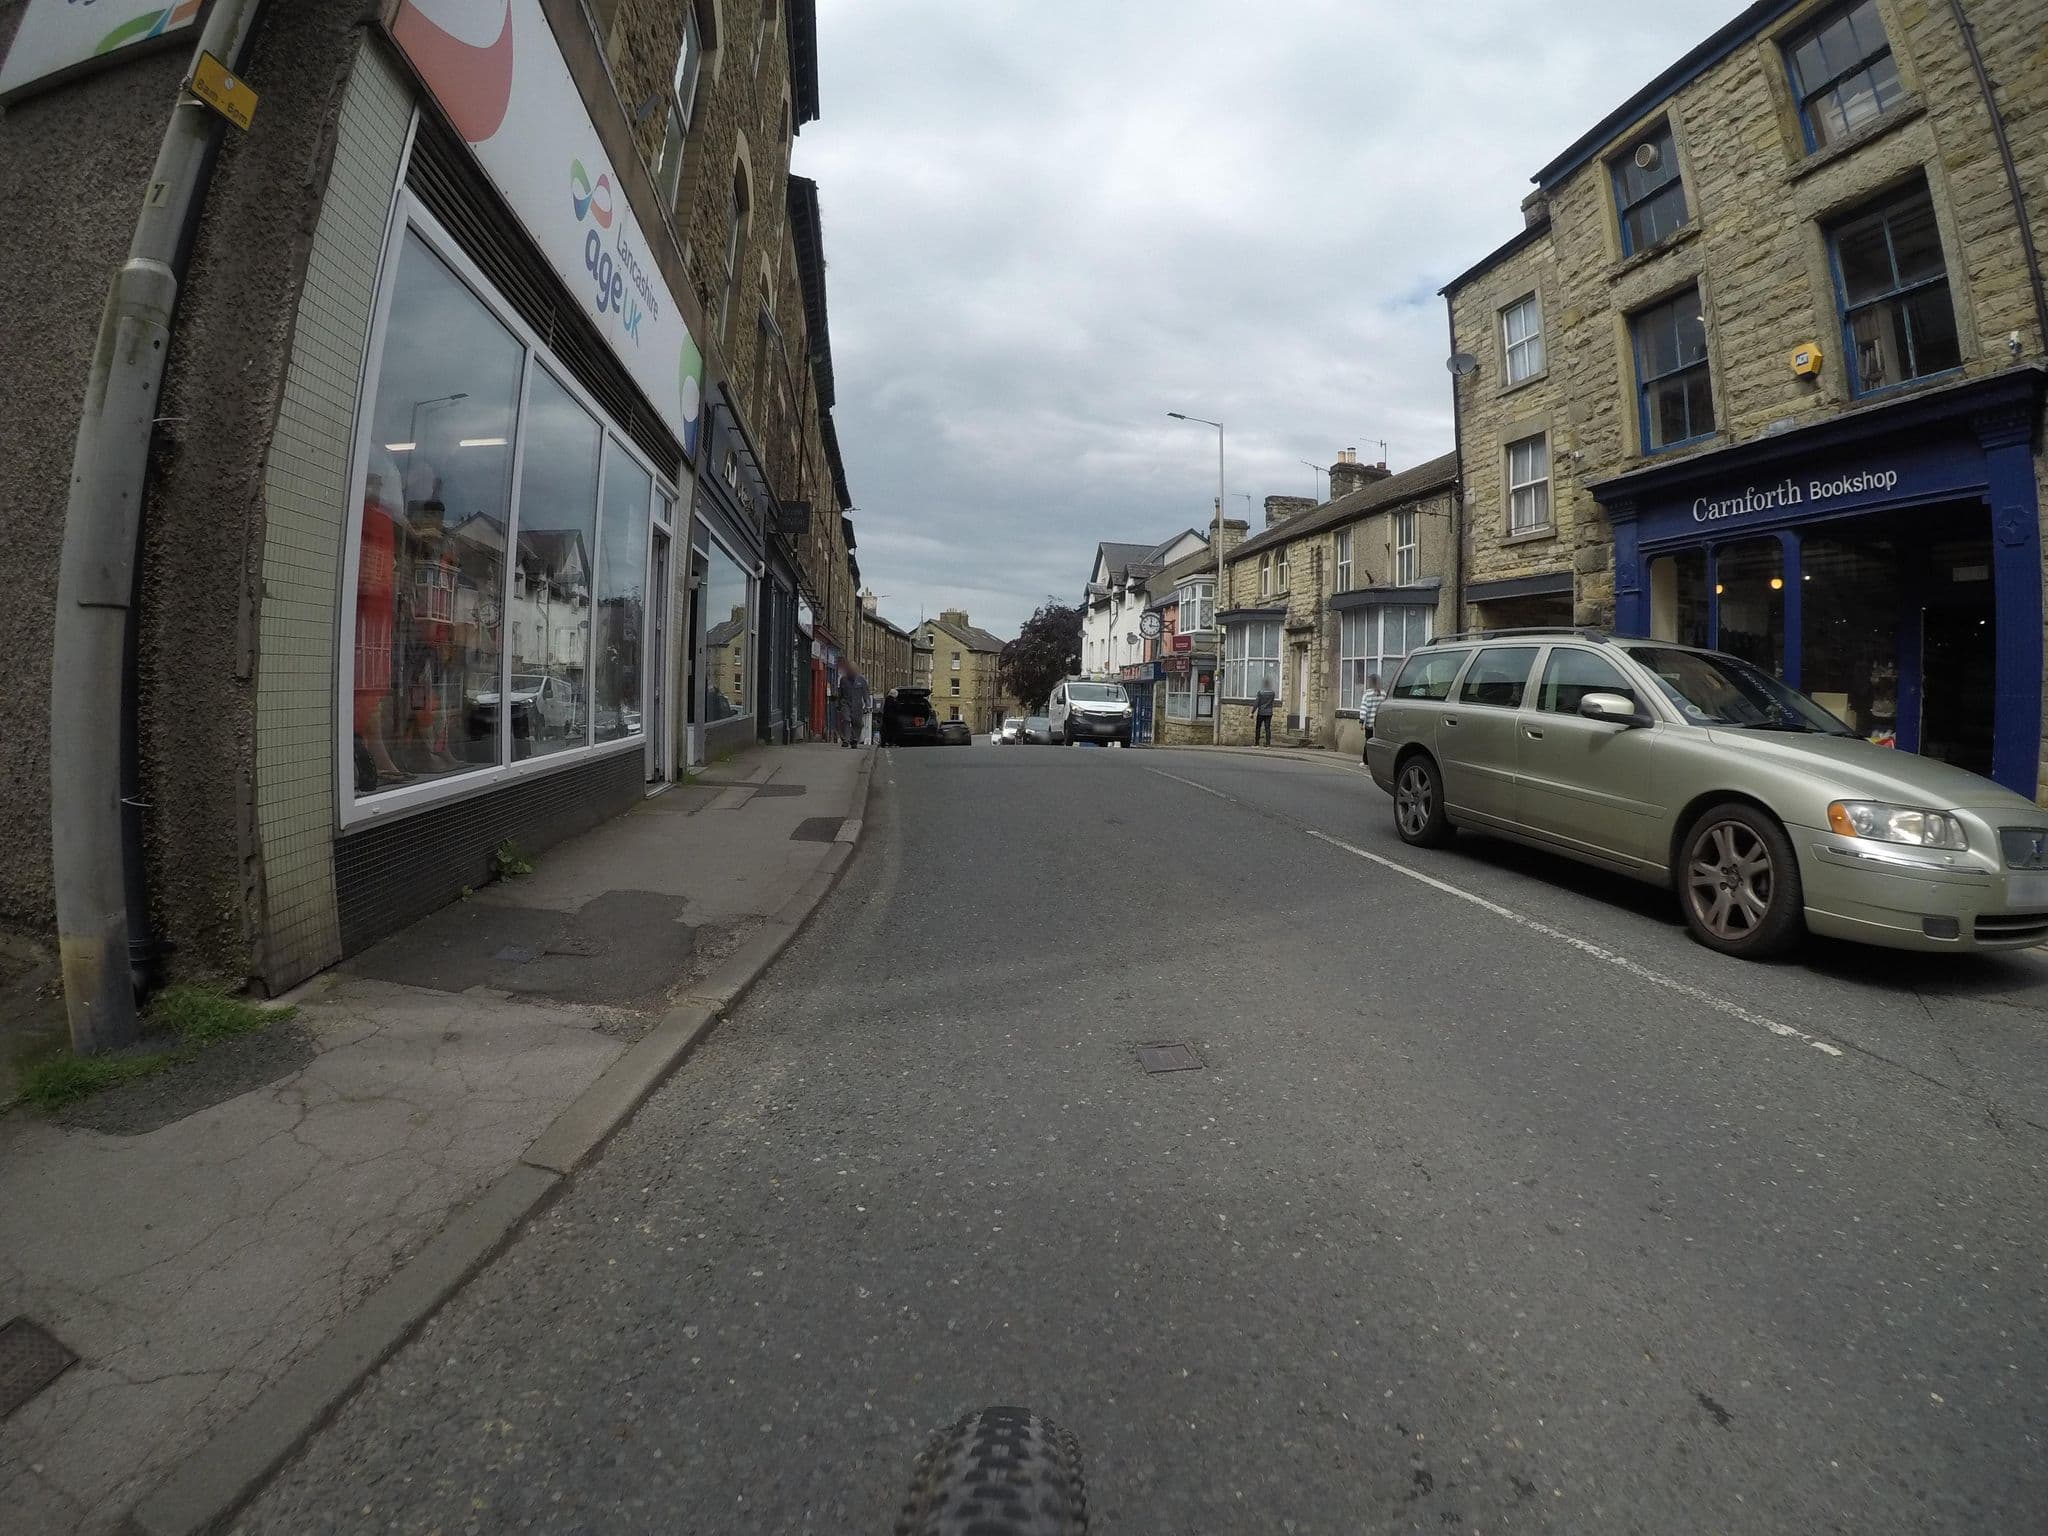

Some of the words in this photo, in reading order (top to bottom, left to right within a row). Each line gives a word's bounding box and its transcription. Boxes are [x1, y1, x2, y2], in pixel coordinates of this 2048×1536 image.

[197, 79, 218, 101] 8am
[227, 103, 248, 125] 6pm
[151, 183, 165, 203] 7
[585, 229, 623, 314] age
[623, 288, 642, 348] UK
[617, 222, 658, 322] Lancashire
[1693, 479, 1803, 522] Carnforth
[1809, 470, 1897, 500] Bookshop
